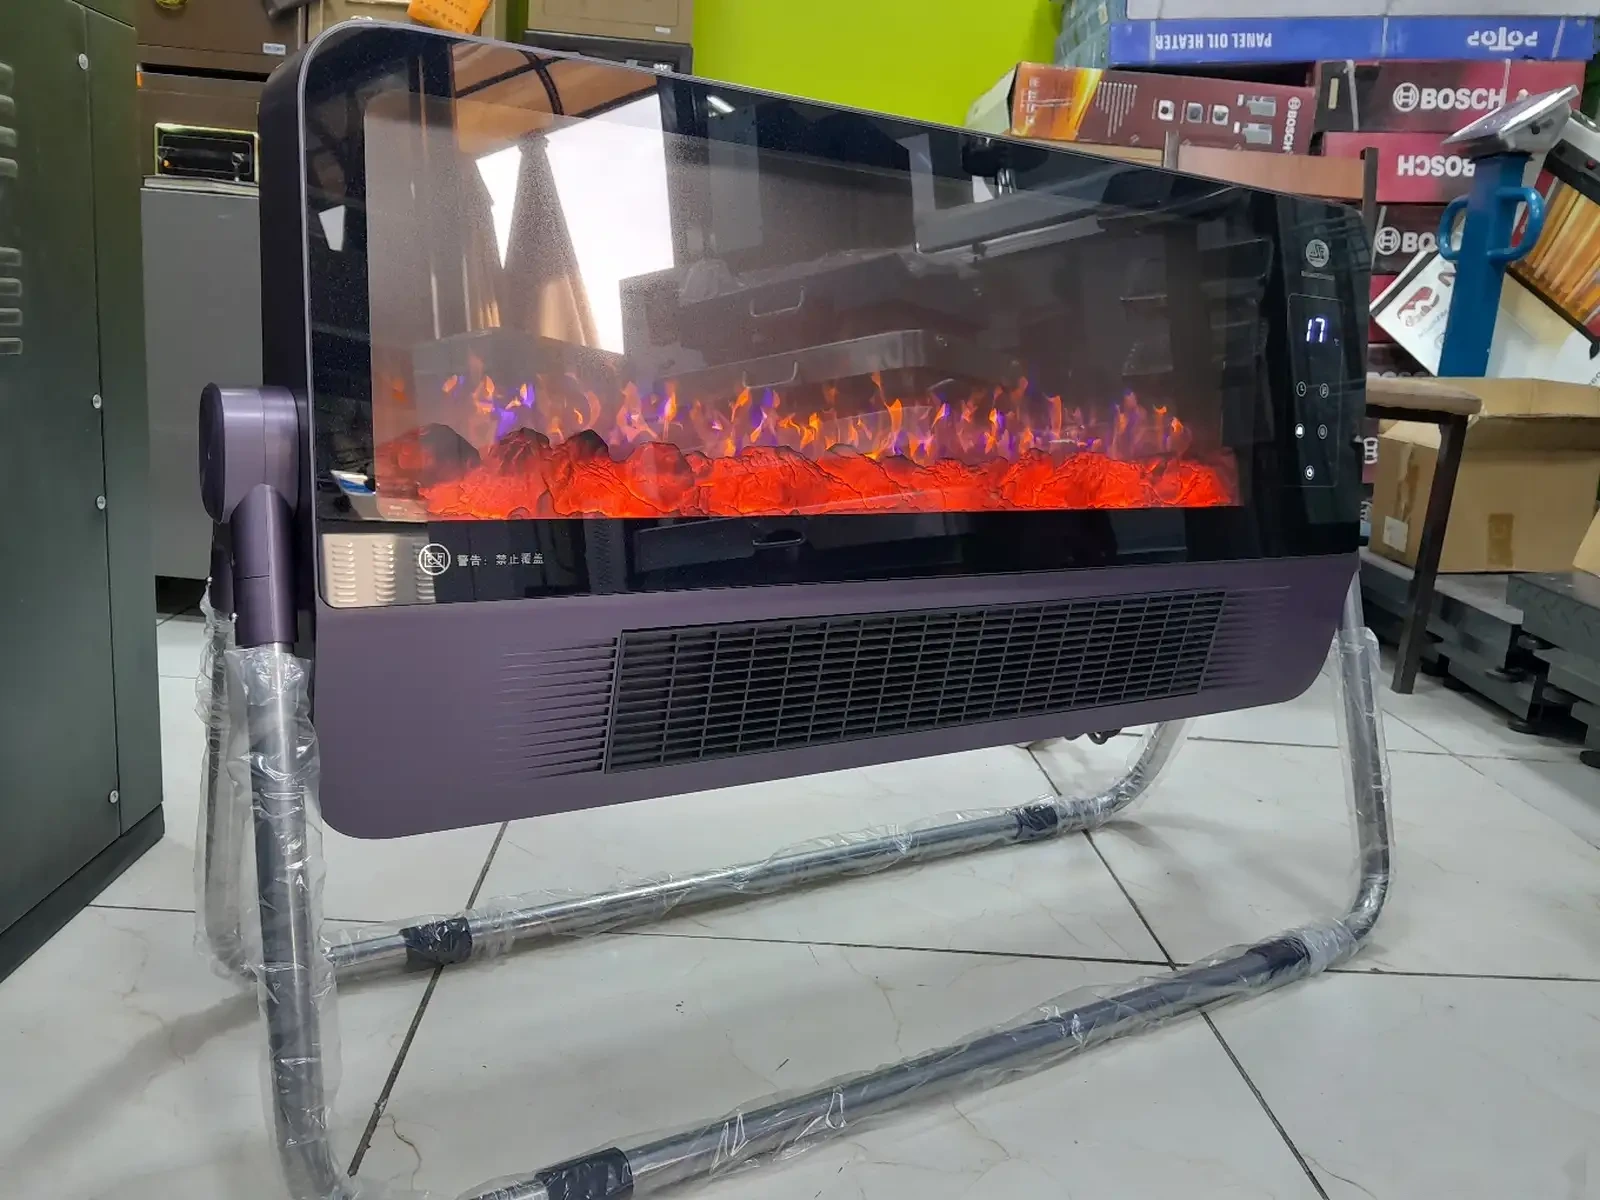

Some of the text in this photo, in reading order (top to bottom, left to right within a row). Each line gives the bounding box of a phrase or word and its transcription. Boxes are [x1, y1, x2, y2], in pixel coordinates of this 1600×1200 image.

[1155, 32, 1273, 51] PANEL OIL HEATER
[1420, 87, 1506, 110] BOSCH
[1282, 109, 1298, 151] BOSCH
[1396, 154, 1476, 178] BOSCH
[1306, 317, 1326, 343] 17
